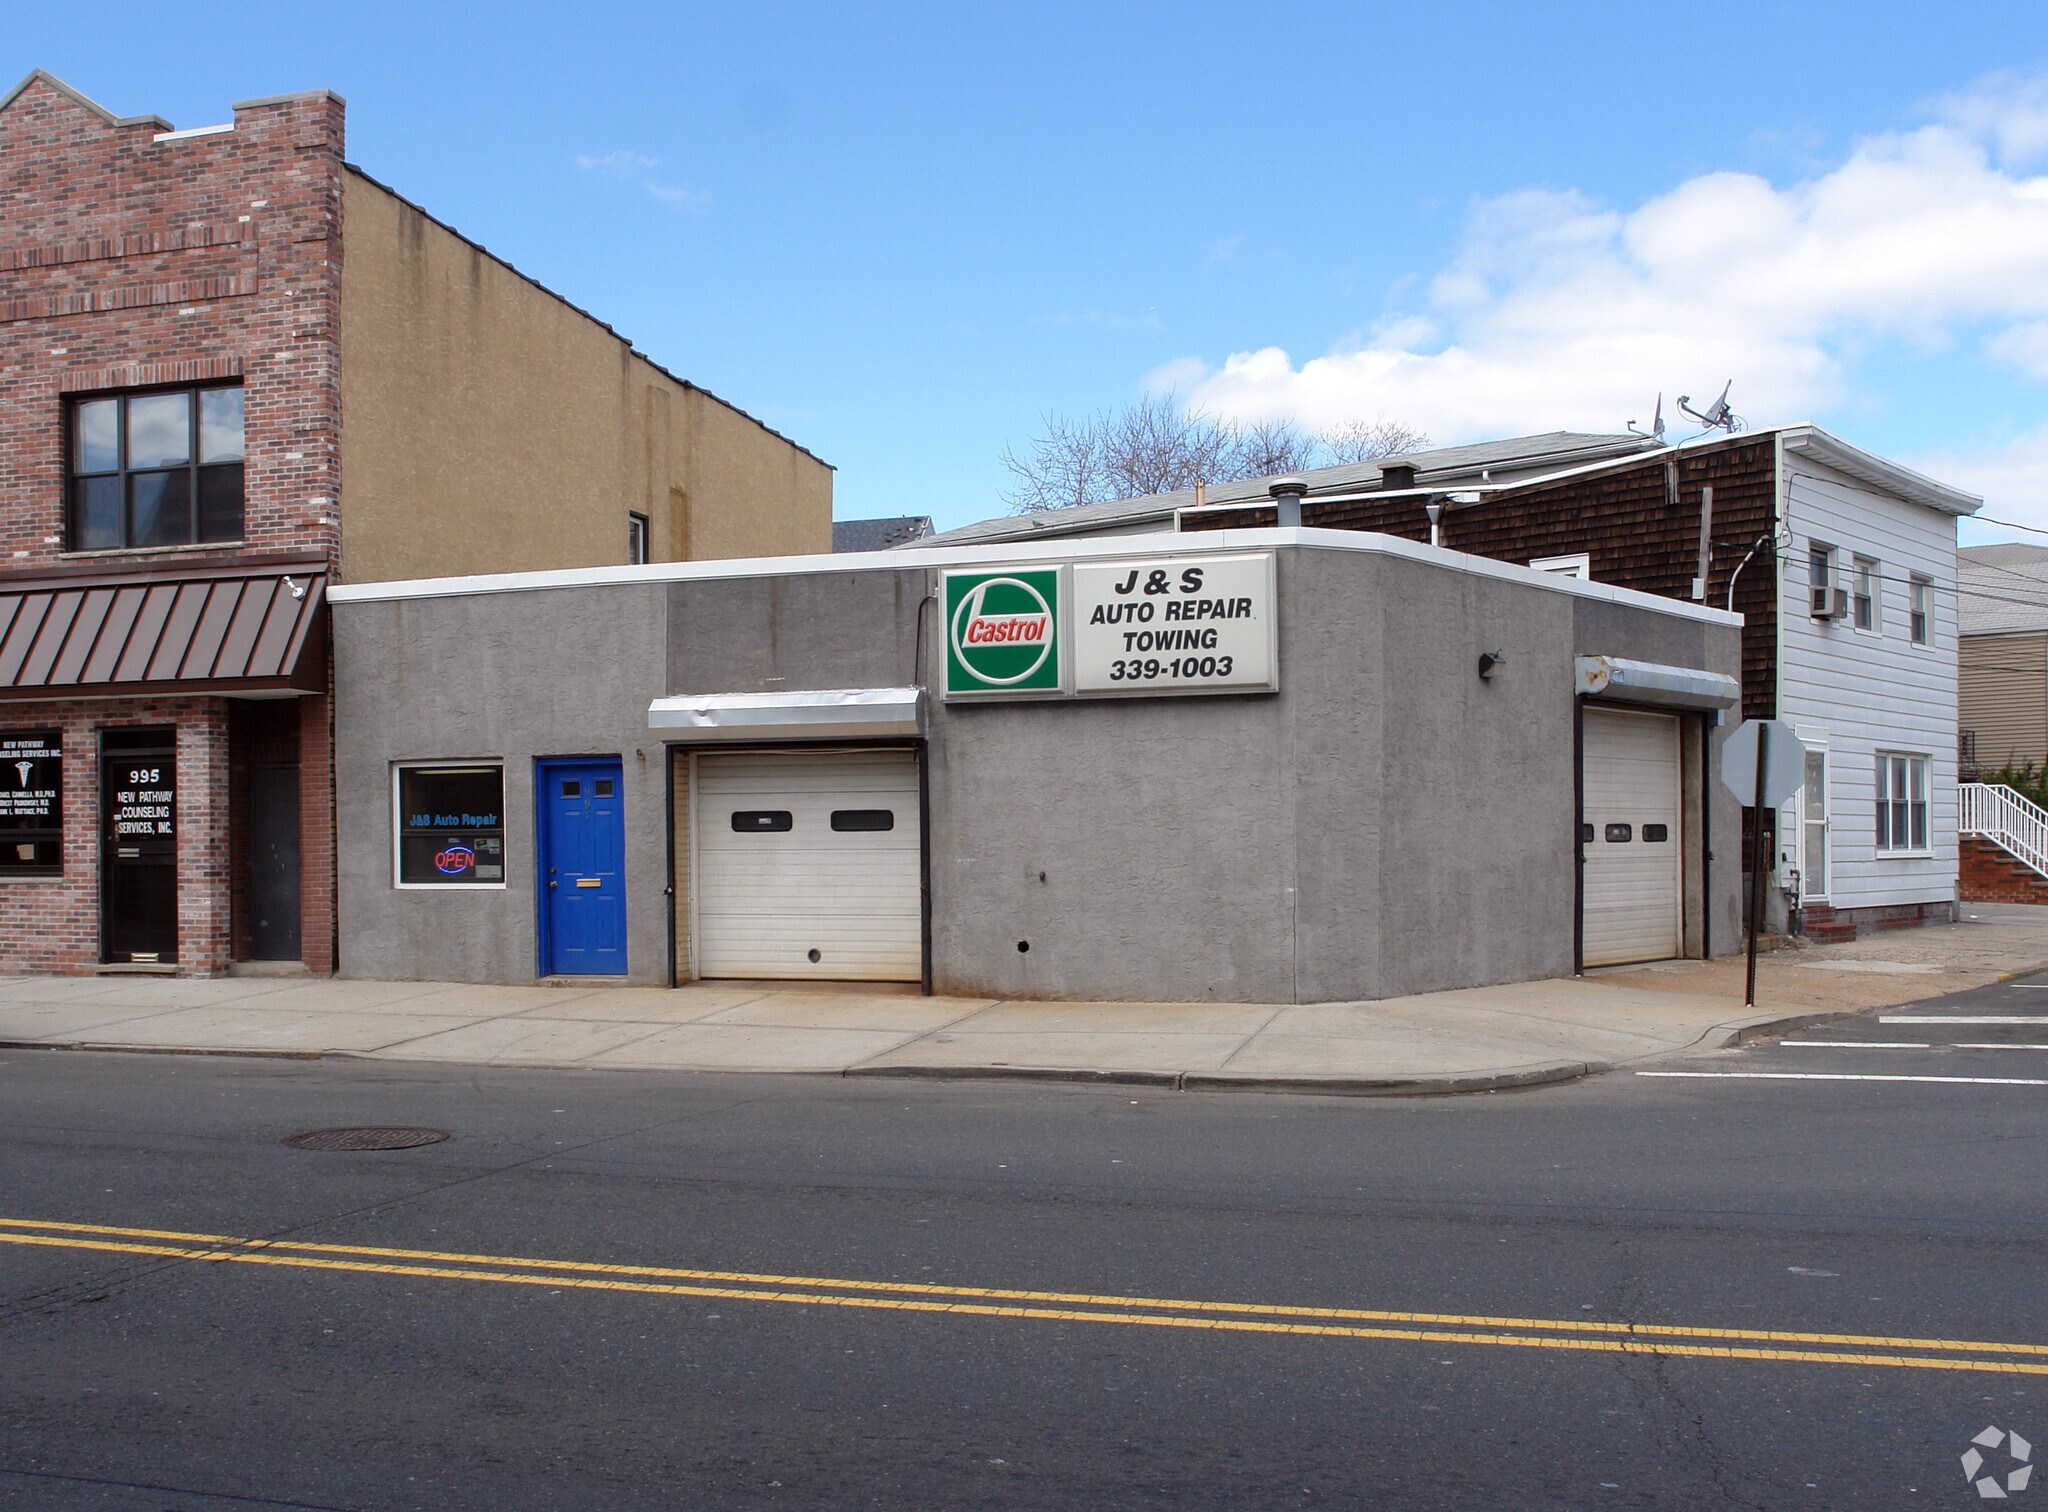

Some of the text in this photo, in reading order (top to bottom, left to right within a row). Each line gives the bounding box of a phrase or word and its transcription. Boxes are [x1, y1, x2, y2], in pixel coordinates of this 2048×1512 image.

[1114, 568, 1204, 595] J & S
[1090, 598, 1252, 625] AUTO REPAIR
[968, 616, 1047, 644] Castrol
[1123, 628, 1218, 652] TOWING
[1110, 656, 1234, 680] 339-1003
[3, 740, 45, 749] NEW PATHWAY
[22, 749, 50, 758] SERVICES
[130, 768, 160, 784] 995
[117, 790, 174, 803] NEW PATHWAY
[122, 805, 170, 818] COUNSELING
[118, 821, 155, 835] SERVICES,
[157, 821, 173, 834] INC.
[434, 814, 460, 826] Auto
[462, 812, 498, 828] Repair
[434, 851, 475, 869] OPEN
